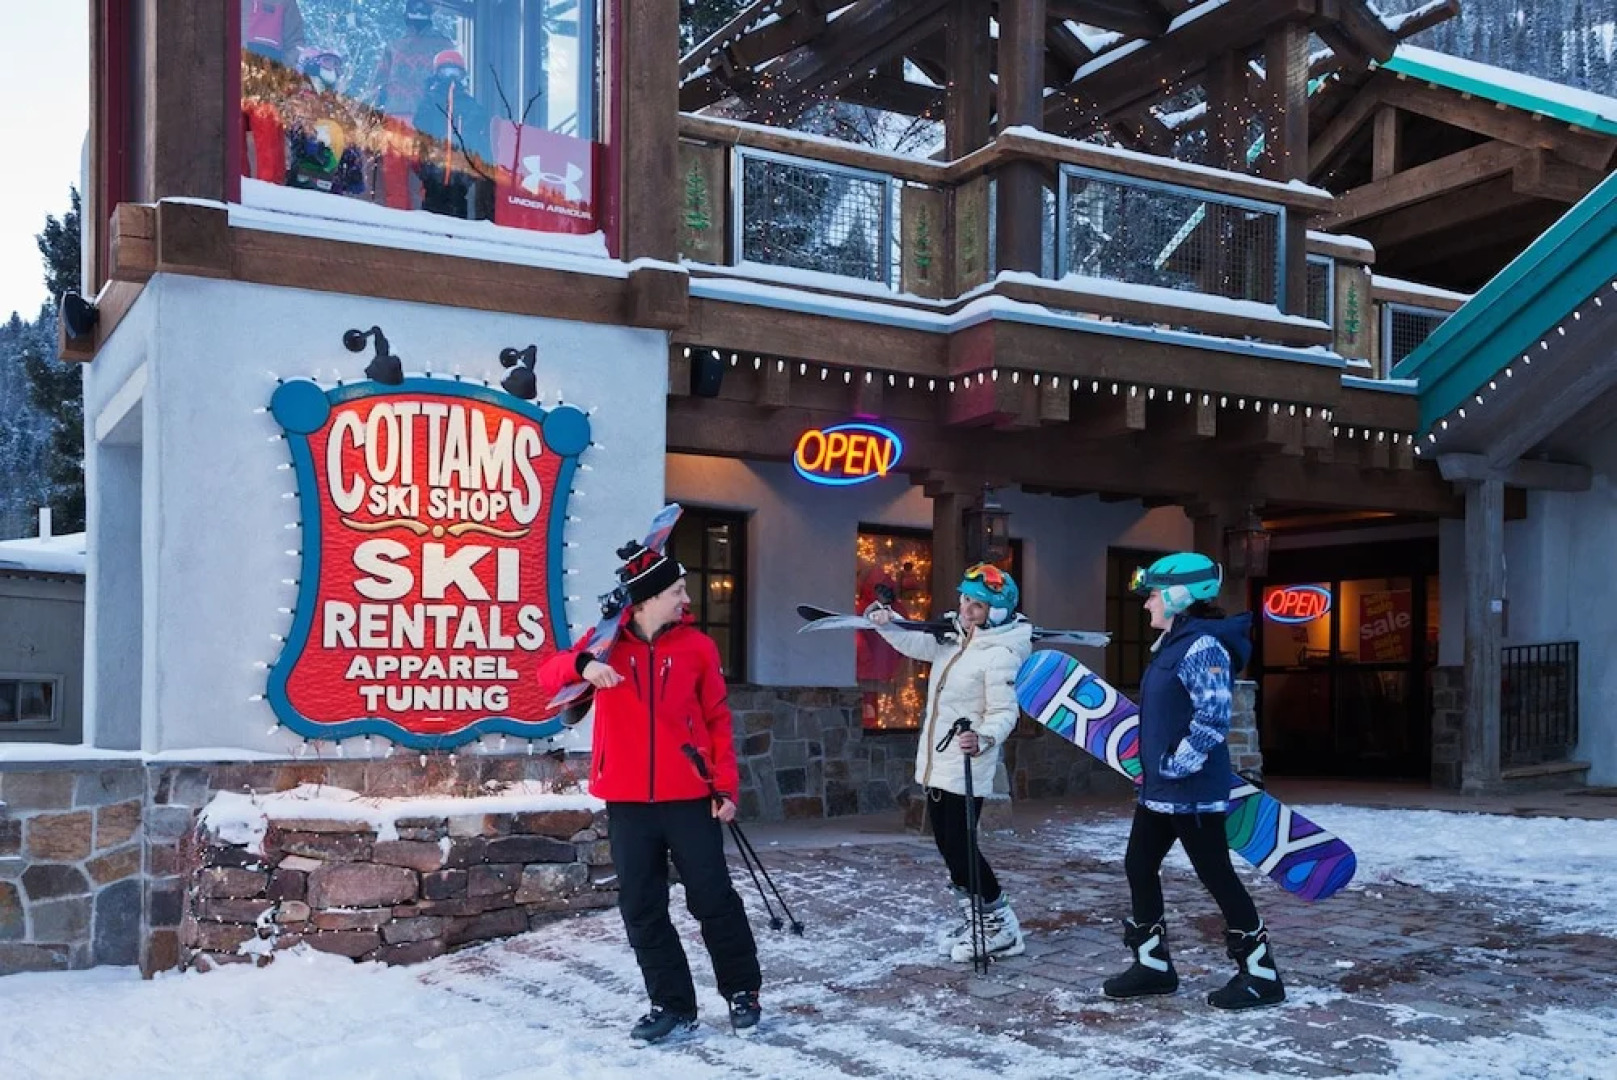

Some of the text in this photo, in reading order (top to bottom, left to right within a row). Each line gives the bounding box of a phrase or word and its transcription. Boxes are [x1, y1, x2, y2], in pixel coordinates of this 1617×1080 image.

[509, 196, 592, 219] UNDER ARMOUR
[326, 402, 542, 524] COTTAMS
[796, 429, 893, 477] OPEN
[367, 485, 509, 522] SKI SHOP
[353, 539, 520, 602] SKI
[1267, 590, 1326, 617] OPEN
[323, 601, 546, 651] RENTALS
[1360, 610, 1411, 640] sale
[345, 655, 519, 681] APPAREL
[359, 684, 509, 712] TUNING
[1037, 664, 1339, 877] ROY
